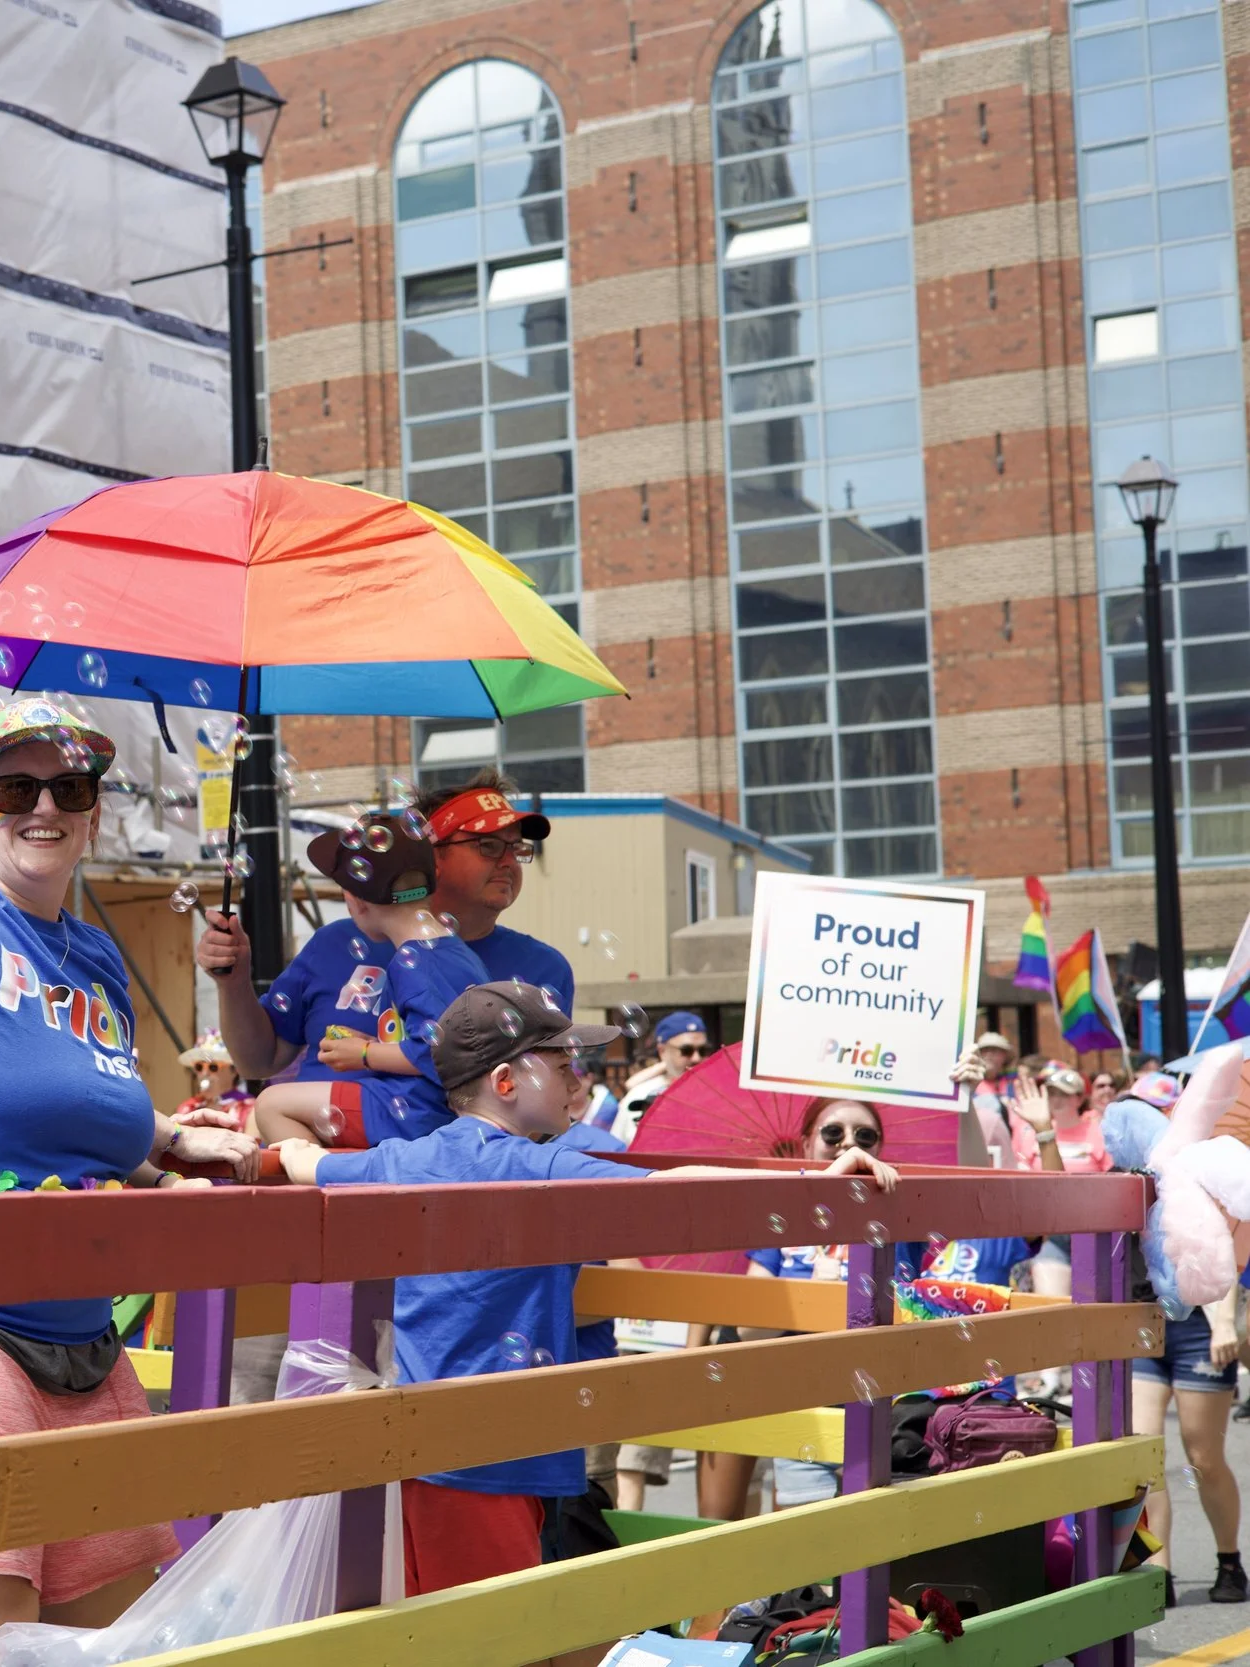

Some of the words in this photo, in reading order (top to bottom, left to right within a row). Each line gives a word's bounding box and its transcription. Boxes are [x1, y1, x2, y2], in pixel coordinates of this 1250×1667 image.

[814, 913, 921, 950] Proud
[821, 952, 853, 977] of
[860, 961, 908, 981] our
[780, 983, 944, 1021] community
[817, 1038, 897, 1069] Pride
[854, 1069, 893, 1082] nscc
